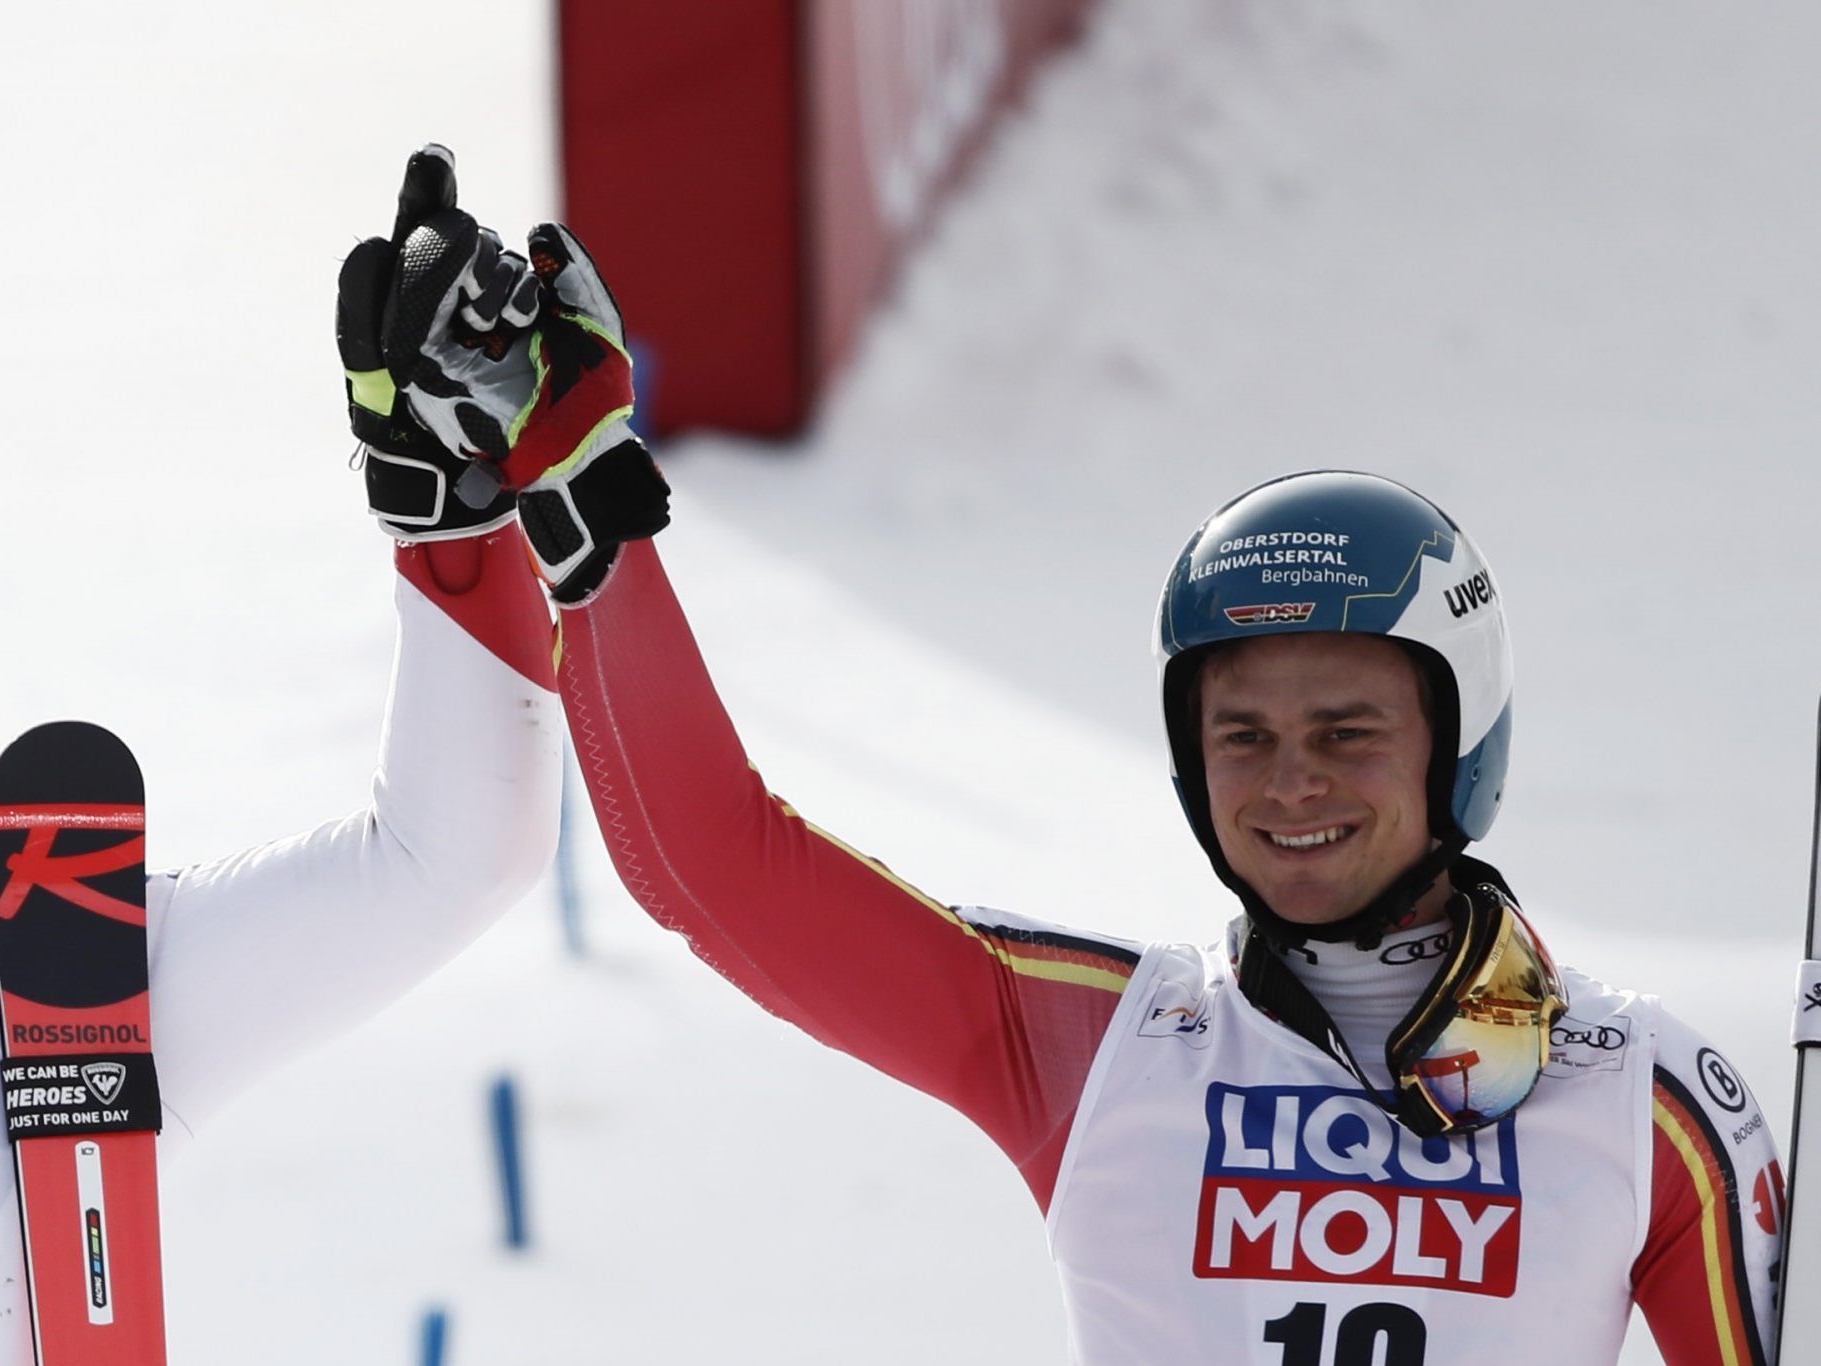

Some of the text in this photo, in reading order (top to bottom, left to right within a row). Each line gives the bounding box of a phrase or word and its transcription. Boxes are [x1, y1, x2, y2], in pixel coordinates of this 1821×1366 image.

[1219, 531, 1350, 554] OBERSTDORF
[1188, 549, 1348, 584] KLEINWALSERTAL
[1261, 567, 1369, 588] Bergbahnen
[12, 1023, 147, 1044] ROSSIGNOL
[3, 1065, 79, 1083] WE CAN BE
[6, 1086, 87, 1110] HEROES
[9, 1109, 129, 1130] JUST FOR ONE DAY
[1221, 1092, 1505, 1186] LIQUI
[1209, 1186, 1516, 1283] MOLY
